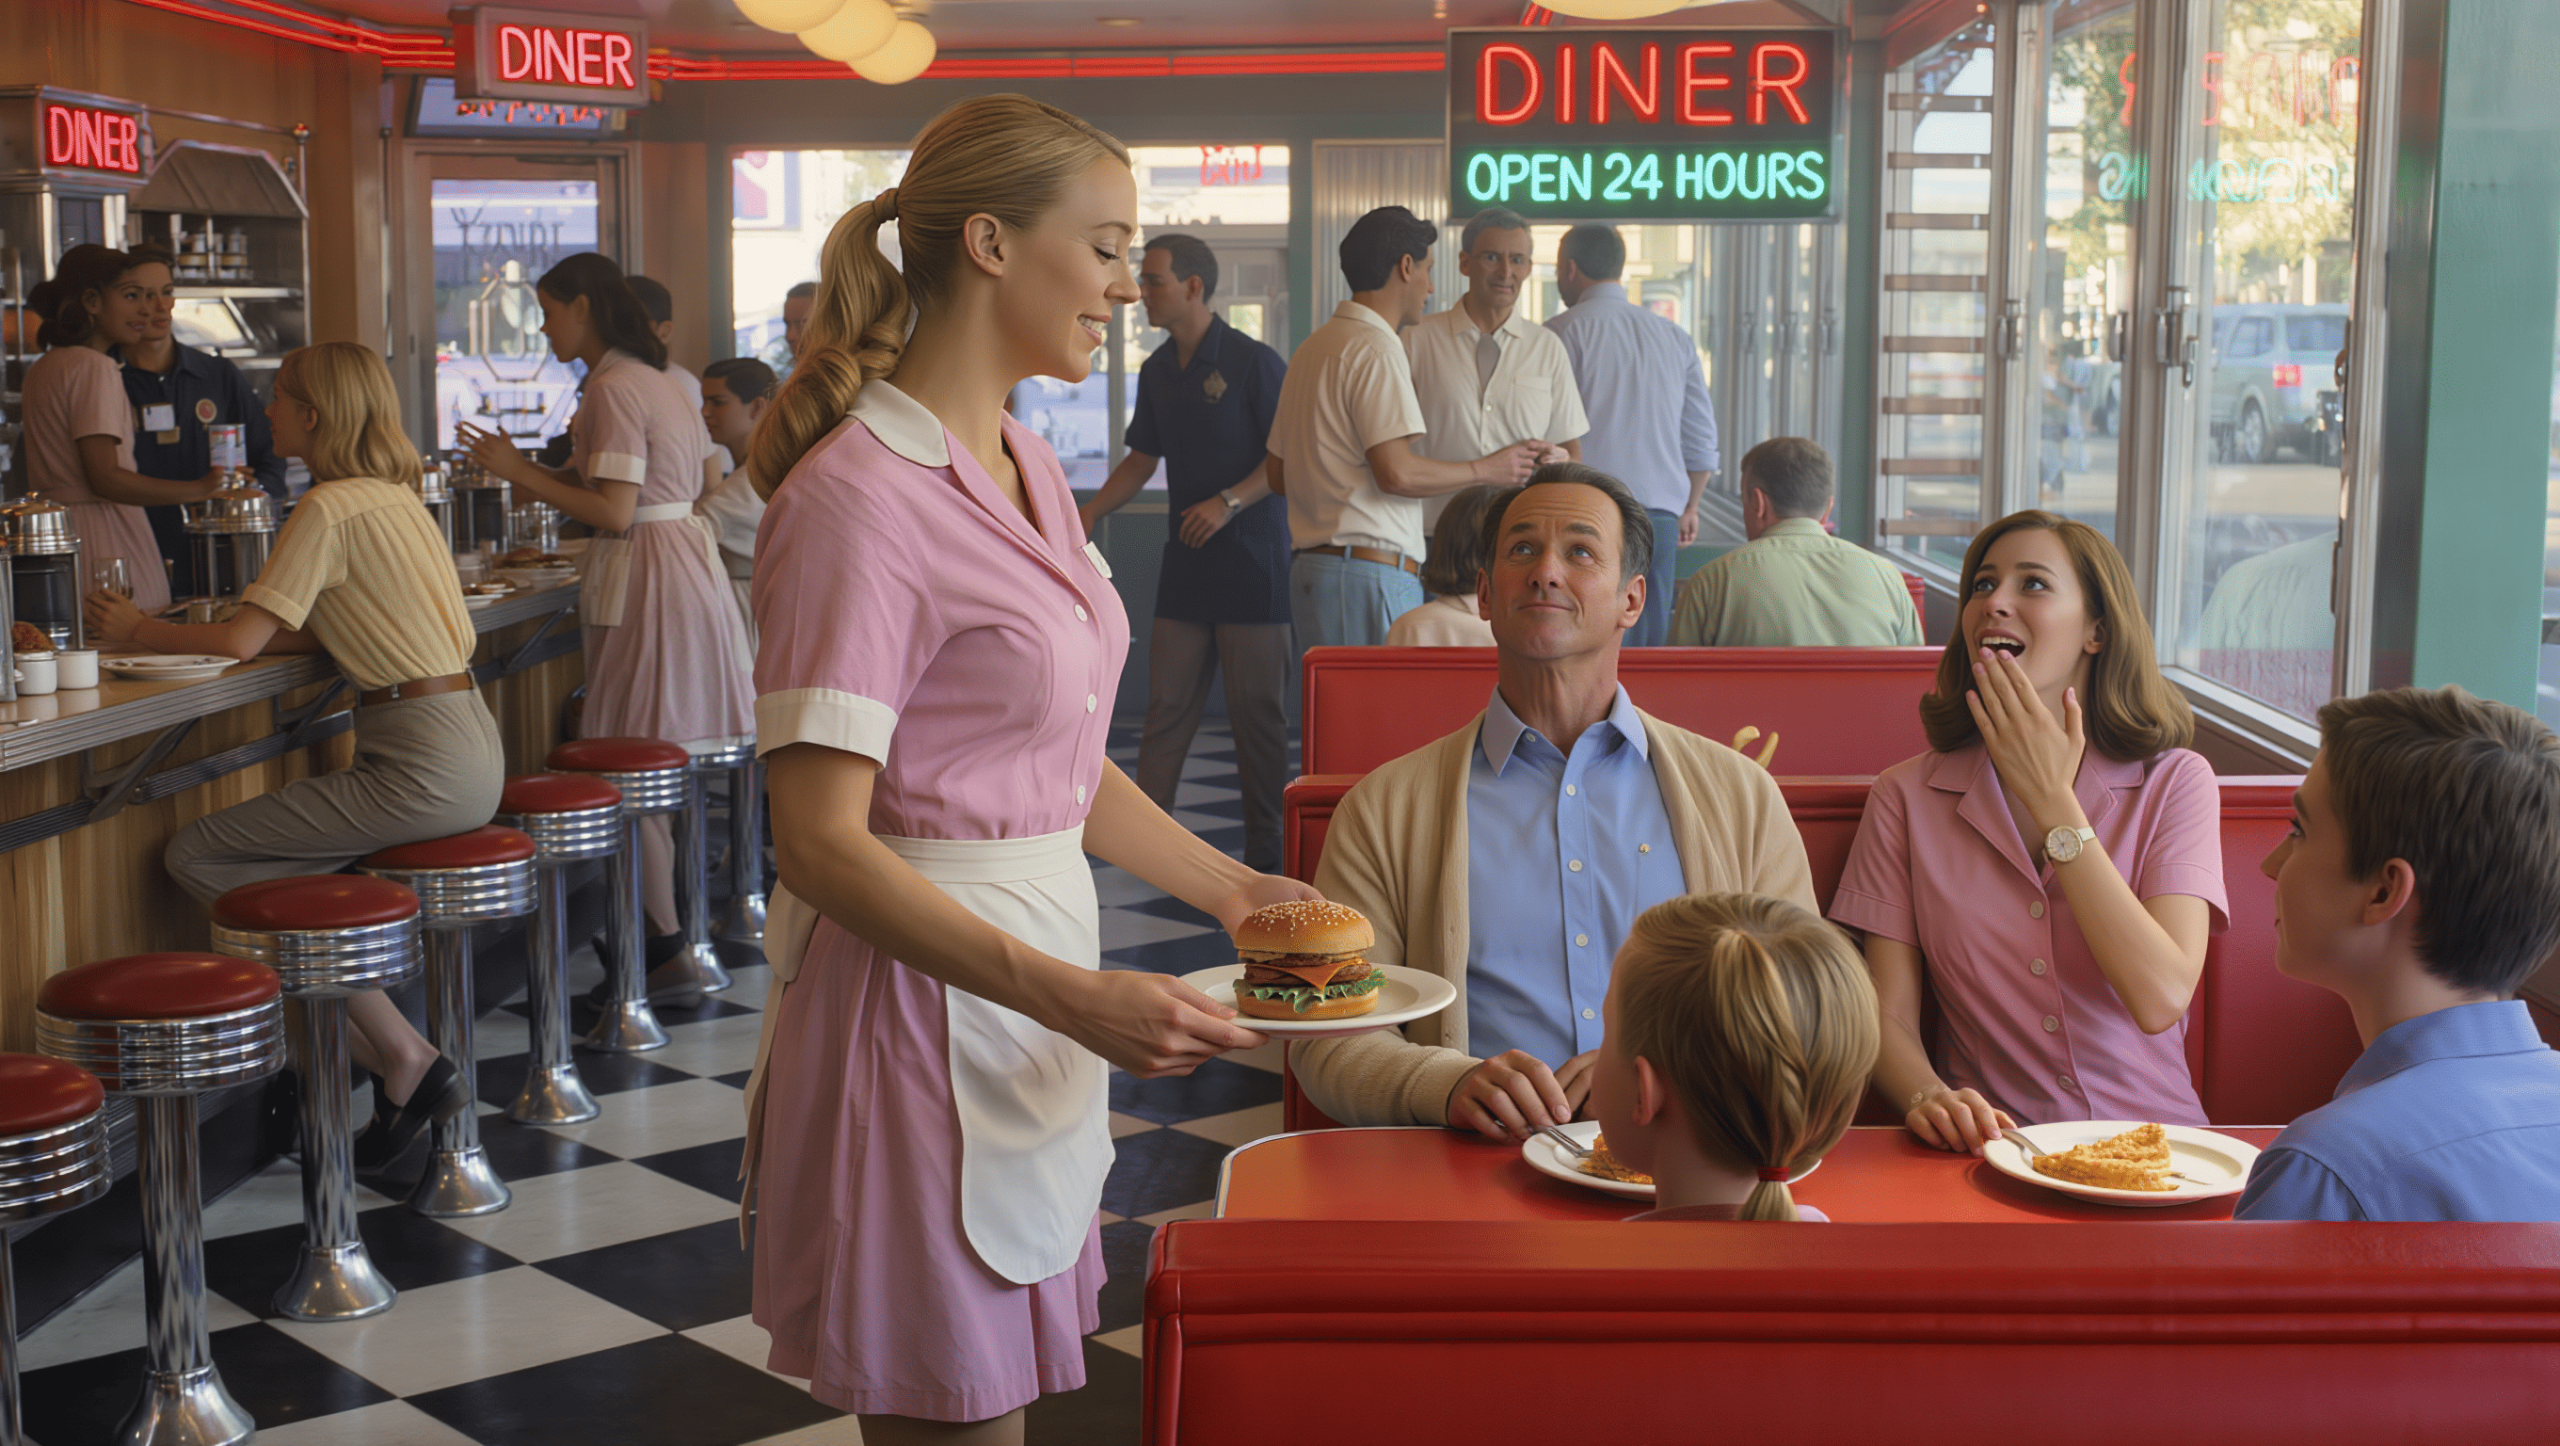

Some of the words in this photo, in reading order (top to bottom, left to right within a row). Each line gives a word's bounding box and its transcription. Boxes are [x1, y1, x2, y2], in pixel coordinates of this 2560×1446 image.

[500, 25, 636, 89] DINER
[1478, 42, 1809, 126] DINER
[1466, 152, 1592, 202] OPEN
[1602, 151, 1664, 201] 24
[1675, 150, 1826, 201] HOURS
